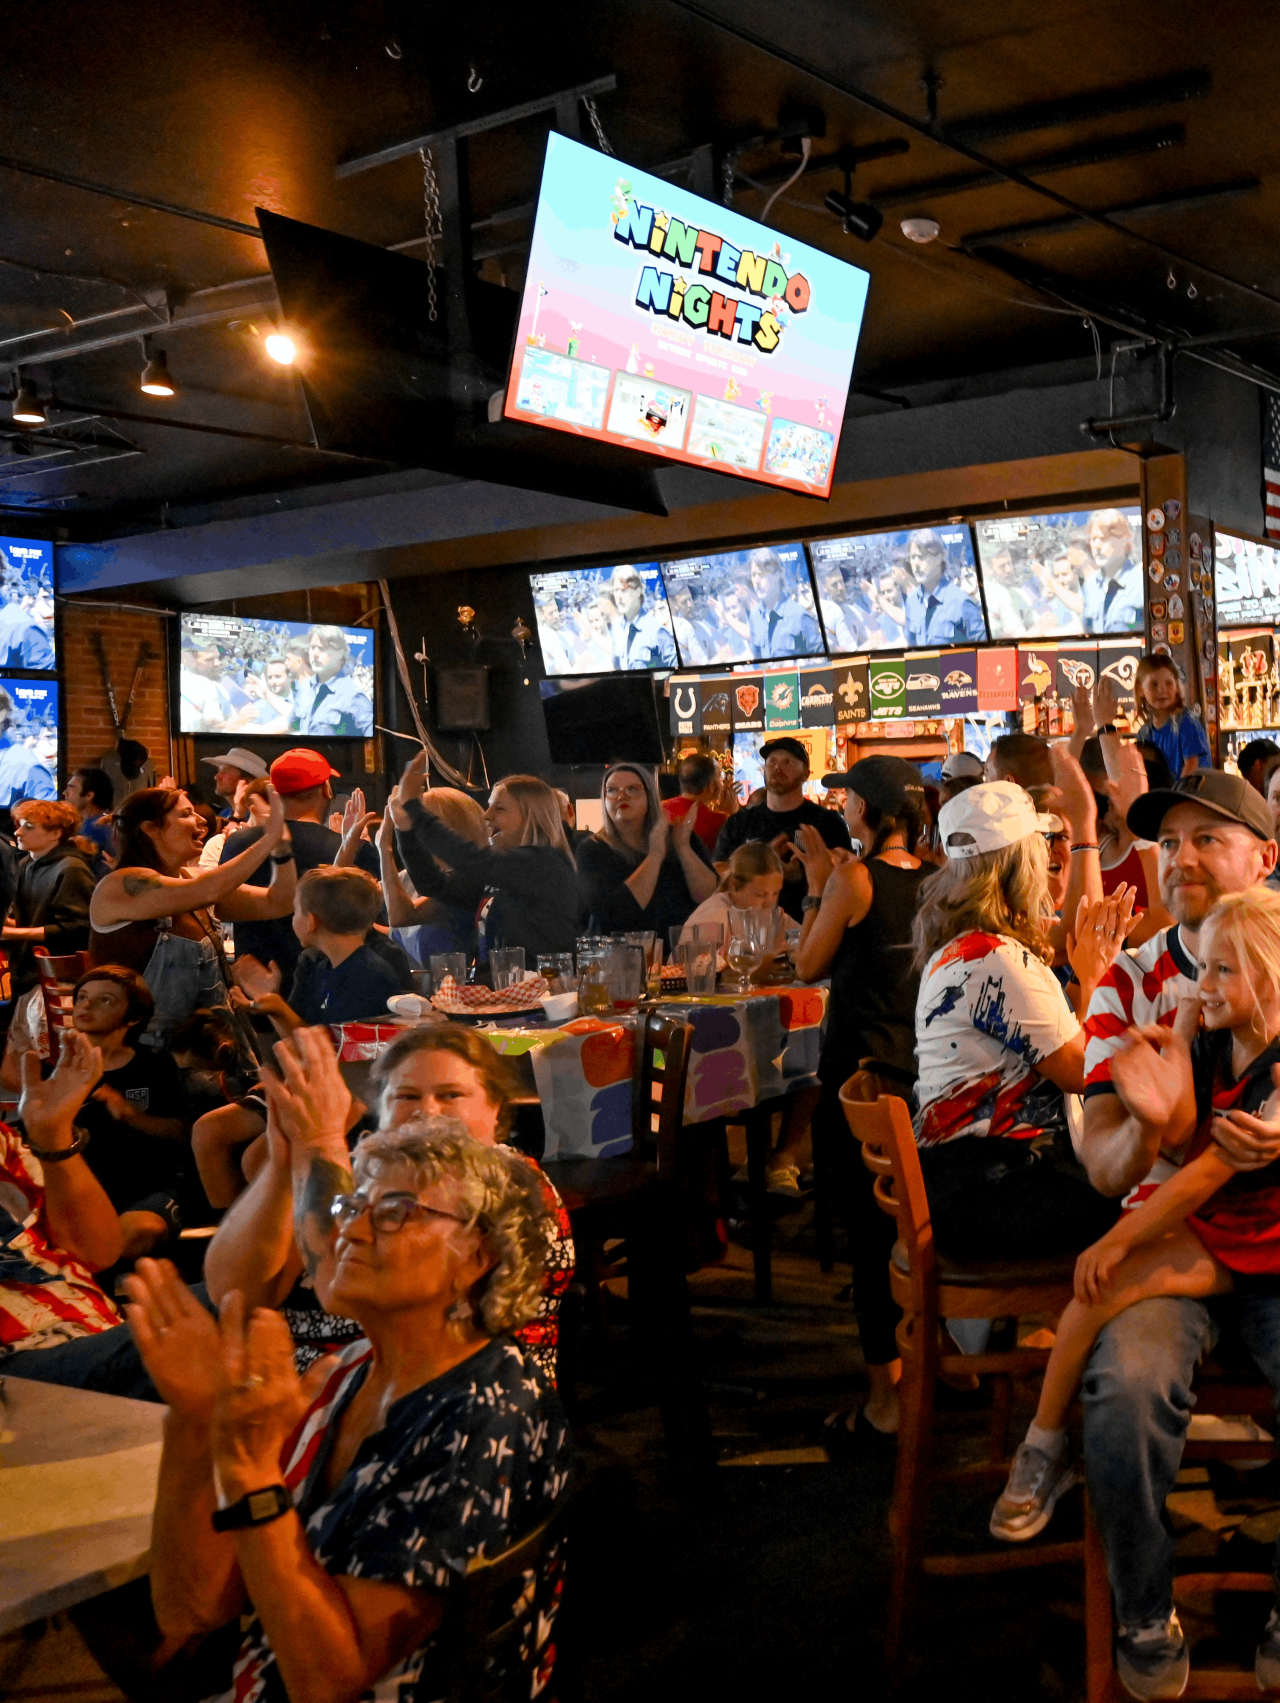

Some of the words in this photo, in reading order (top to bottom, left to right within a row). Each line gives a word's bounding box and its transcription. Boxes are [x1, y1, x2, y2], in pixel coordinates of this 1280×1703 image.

[695, 352, 728, 370] SPORTS
[801, 693, 834, 706] CHARGERS
[941, 689, 978, 700] RAVENS
[873, 706, 903, 716] JETS
[908, 703, 941, 712] SEAHAWKS
[837, 707, 867, 720] SAINTS
[703, 723, 731, 731] PANTHERS
[734, 720, 763, 730] BEARS
[769, 719, 797, 729] Dolphins
